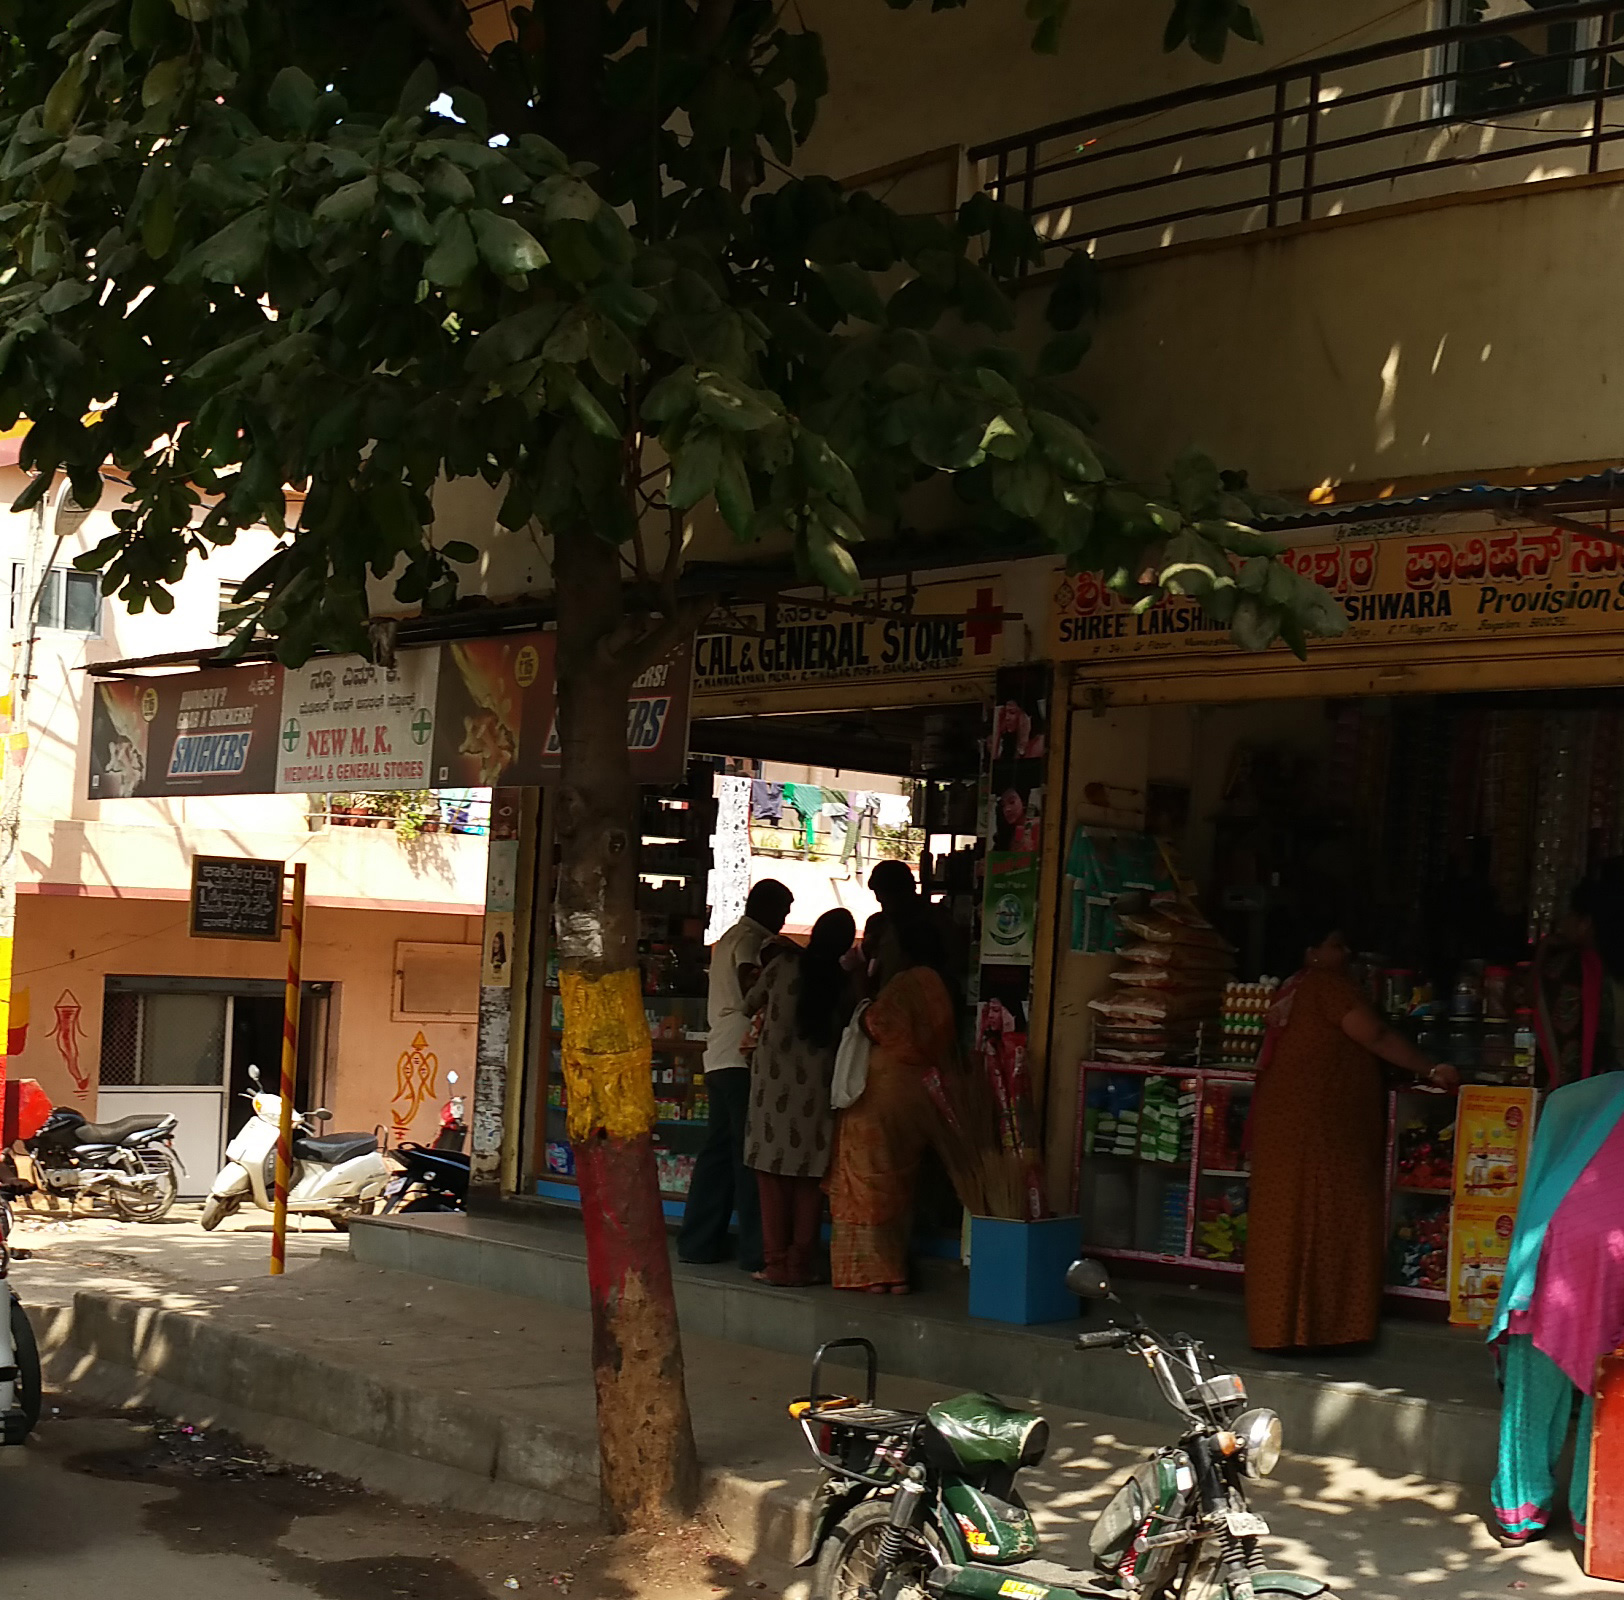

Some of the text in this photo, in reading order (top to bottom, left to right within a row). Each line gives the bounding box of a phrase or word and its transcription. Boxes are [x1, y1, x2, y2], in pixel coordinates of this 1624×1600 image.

[1476, 582, 1610, 615] Provision
[1059, 612, 1129, 643] SHREE
[759, 619, 965, 673] GENERAL STORE
[171, 732, 252, 774] SNICKERS
[306, 725, 392, 758] NEW M. K.
[284, 764, 324, 783] MEDICAL
[336, 762, 381, 780] GENERAL
[383, 760, 424, 779] STORES
